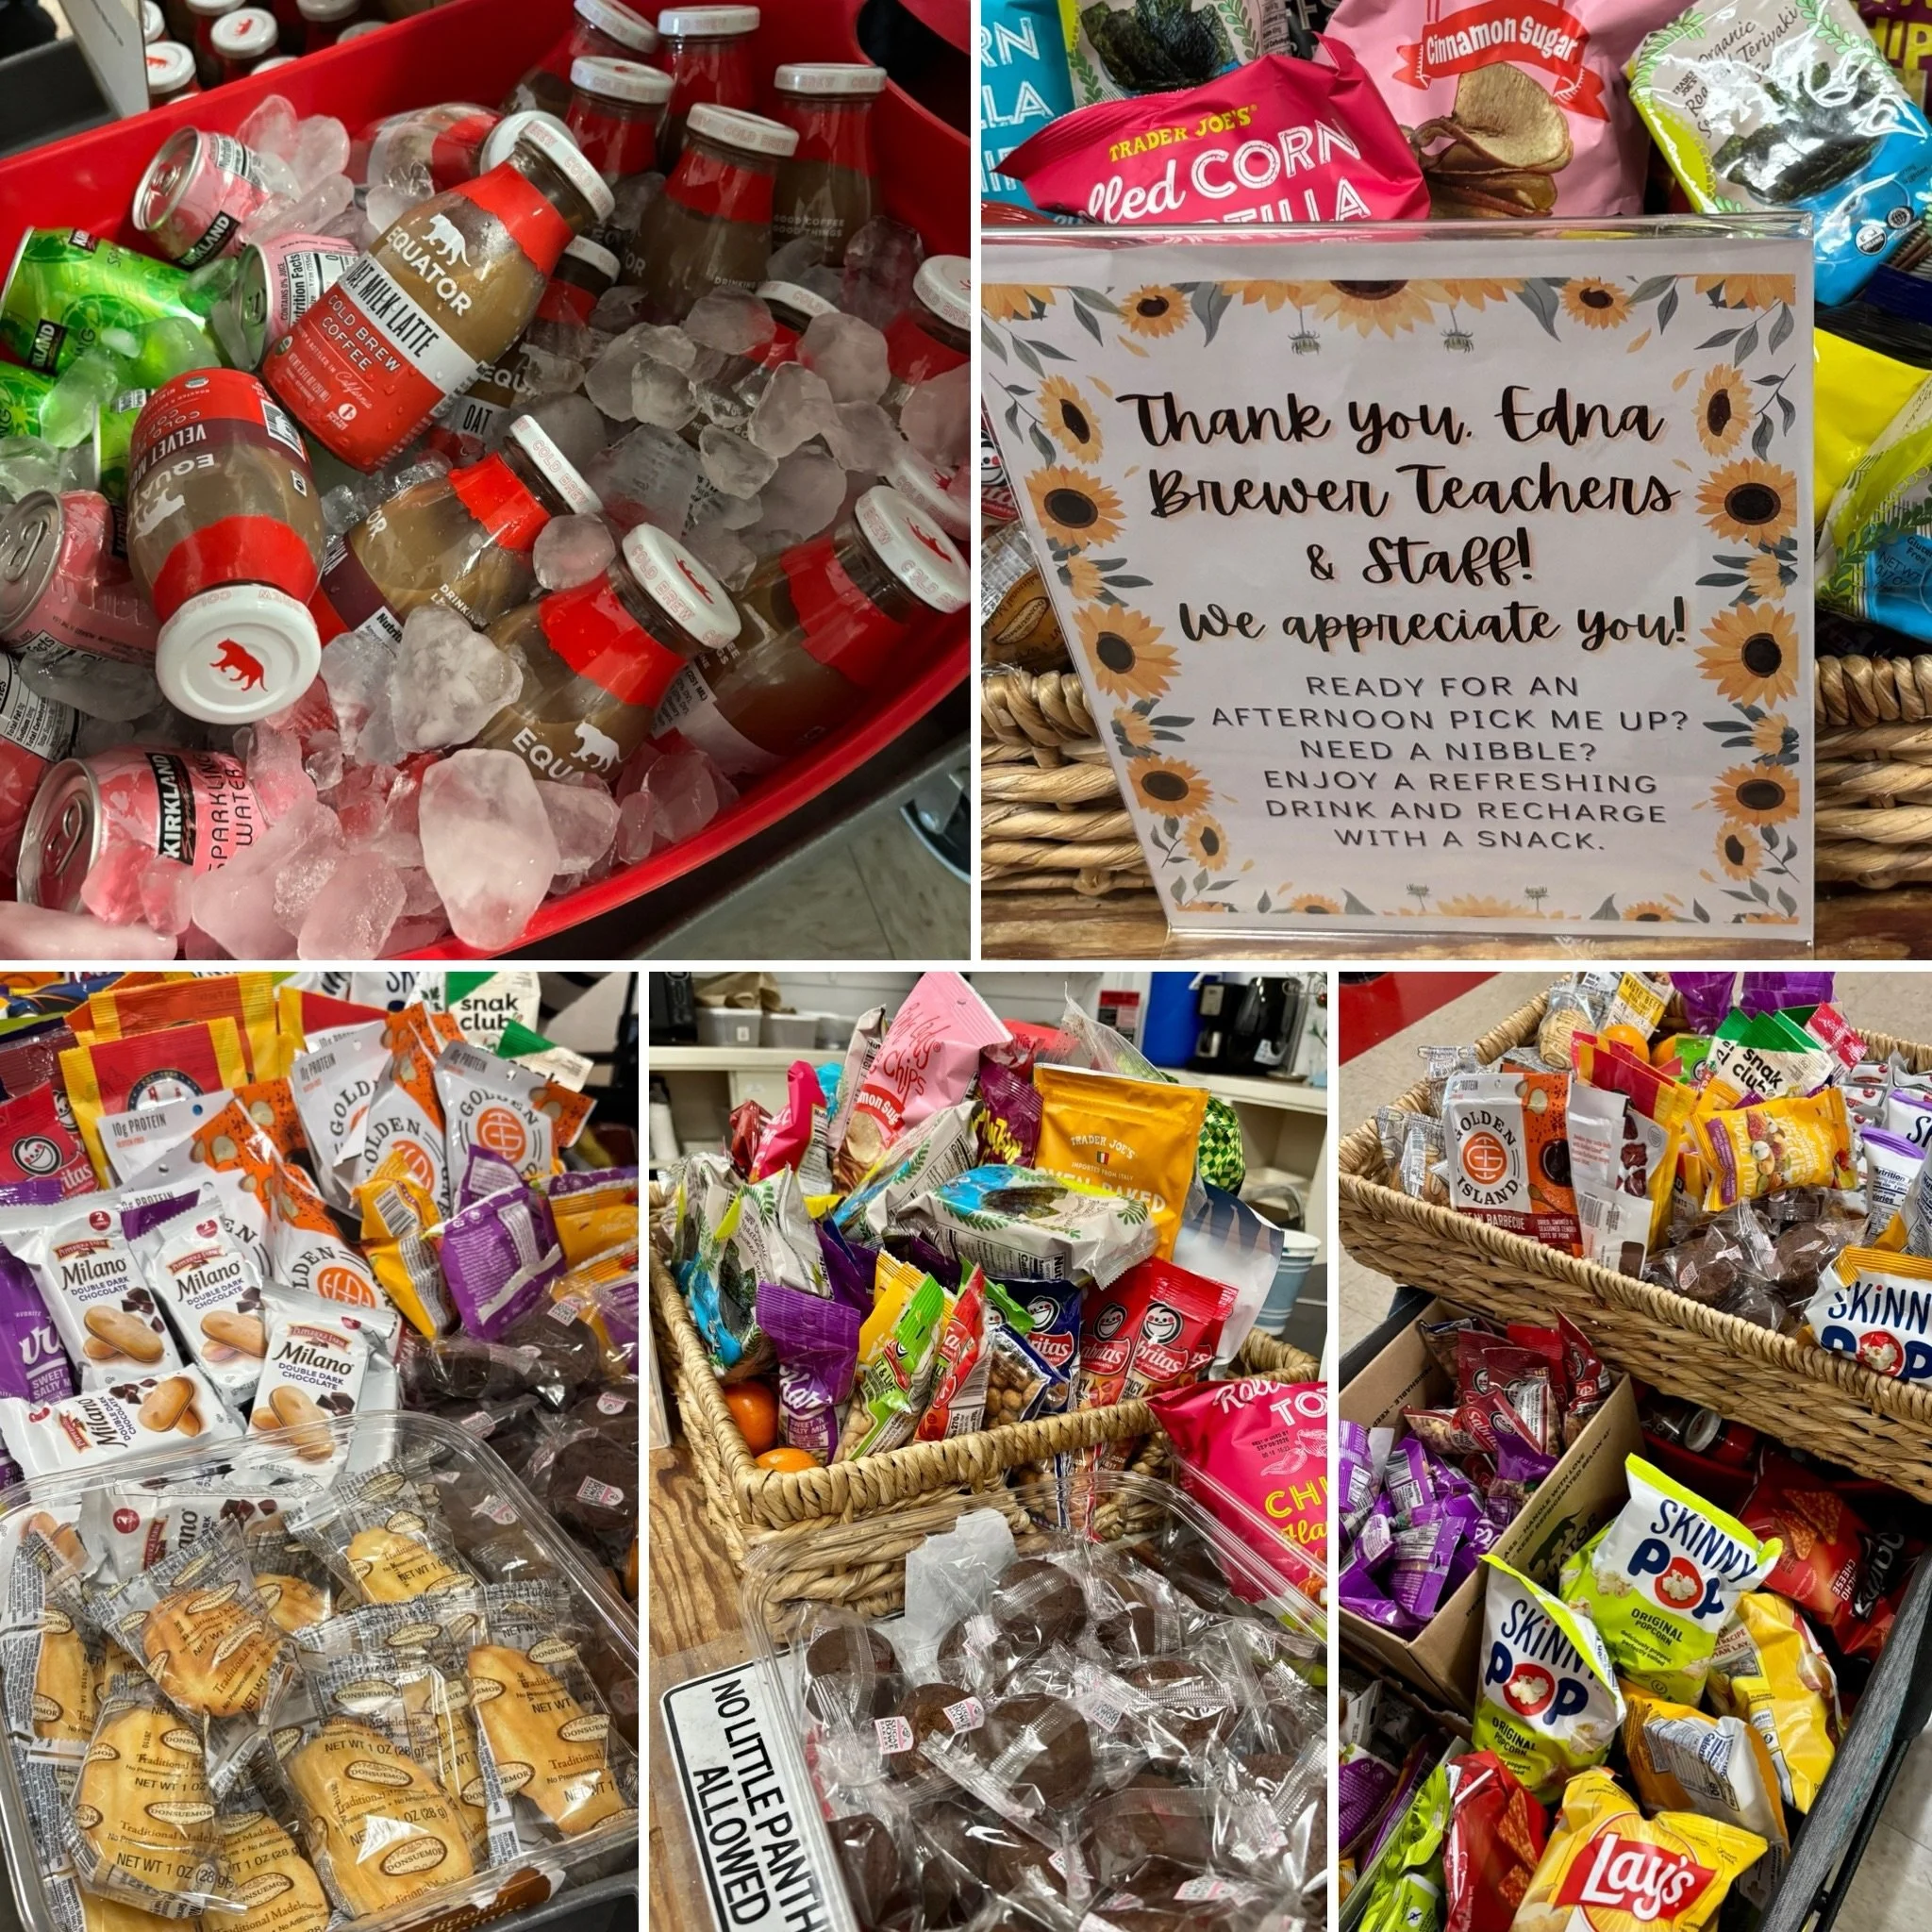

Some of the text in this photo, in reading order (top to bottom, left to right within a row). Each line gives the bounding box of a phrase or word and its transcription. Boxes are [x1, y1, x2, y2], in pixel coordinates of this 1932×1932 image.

[1426, 16, 1579, 64] Cinnamon Sugar
[1698, 20, 1757, 64] Organic
[1736, 6, 1800, 62] Teriyaki
[1109, 107, 1252, 162] TRADER JOE'S
[1191, 119, 1361, 199] CORN
[291, 253, 302, 276] Facts
[386, 225, 473, 317] EQUATOR
[345, 260, 440, 358] OAT MILK LATTE
[322, 316, 373, 373] COFFEE
[327, 294, 401, 374] COLD BREW
[462, 404, 493, 435] OAT
[1116, 391, 1331, 447] Thank
[1494, 385, 1665, 446] Edna
[532, 439, 560, 473] COLD
[1150, 462, 1682, 518] Brewer Teachers
[1307, 526, 1534, 587] & Staff!
[629, 542, 658, 593] COLD
[655, 582, 694, 625] BREW
[1179, 596, 1687, 653] We appreciate you!
[1307, 676, 1579, 698] READY FOR AN
[1212, 708, 1690, 733] AFTERNOON PICK ME UP?
[1300, 741, 1597, 762] NEED A NIBBLE?
[1264, 770, 1657, 794] ENJOY A REFRESHING
[159, 755, 180, 858] KIRKLAND
[234, 767, 254, 847] WATER
[1266, 799, 1667, 824] DRINK AND RECHARGE
[1334, 827, 1607, 851] WITH A SNACK.
[460, 993, 520, 1012] snak
[460, 1012, 510, 1032] club
[461, 1051, 489, 1073] PROTEIN
[1743, 1047, 1783, 1091] snak
[883, 1050, 927, 1108] Chips
[128, 1113, 167, 1132] PROTEIN
[1455, 1109, 1517, 1147] GOLDEN
[1071, 1135, 1137, 1160] TRADER JOE'S
[1457, 1175, 1519, 1206] ISLAND
[1487, 1213, 1525, 1231] BARBECUE
[61, 1257, 126, 1291] Milano
[71, 1275, 130, 1296] DOUBLE DARK
[177, 1261, 241, 1302] Milano
[78, 1284, 129, 1302] CHOCOLATE
[187, 1277, 245, 1306] DOUBLE DARK
[194, 1286, 243, 1310] CHOCOLATE
[272, 1341, 353, 1375] Milano
[278, 1362, 344, 1385] DOUBLE DARK
[282, 1371, 339, 1391] CHOCOLATE
[77, 1398, 128, 1448] Milano
[1522, 1454, 1586, 1533] HANDLE WITH LOVE
[1832, 1558, 1857, 1596] CHEESE
[1631, 1607, 1683, 1643] ORIGINAL
[1635, 1620, 1673, 1646] POPCORN
[711, 1678, 751, 1719] NO
[325, 1739, 393, 1756] NET WT OZ
[1491, 1717, 1537, 1752] ORIGINAL
[1493, 1732, 1527, 1757] POPCORN
[549, 1750, 604, 1770] Traditional
[724, 1717, 786, 1817] LITTLE
[135, 1777, 178, 1791] NET WT
[149, 1807, 214, 1818] DONSUEMOR
[403, 1808, 421, 1824] OZ
[121, 1820, 177, 1840] Traditional
[693, 1765, 771, 1925] ALLOWED
[117, 1852, 194, 1880] NET WT 1 OZ
[254, 1854, 270, 1865] OZ
[387, 1845, 443, 1872] DONSUEMOR
[1580, 1832, 1696, 1922] Lay's
